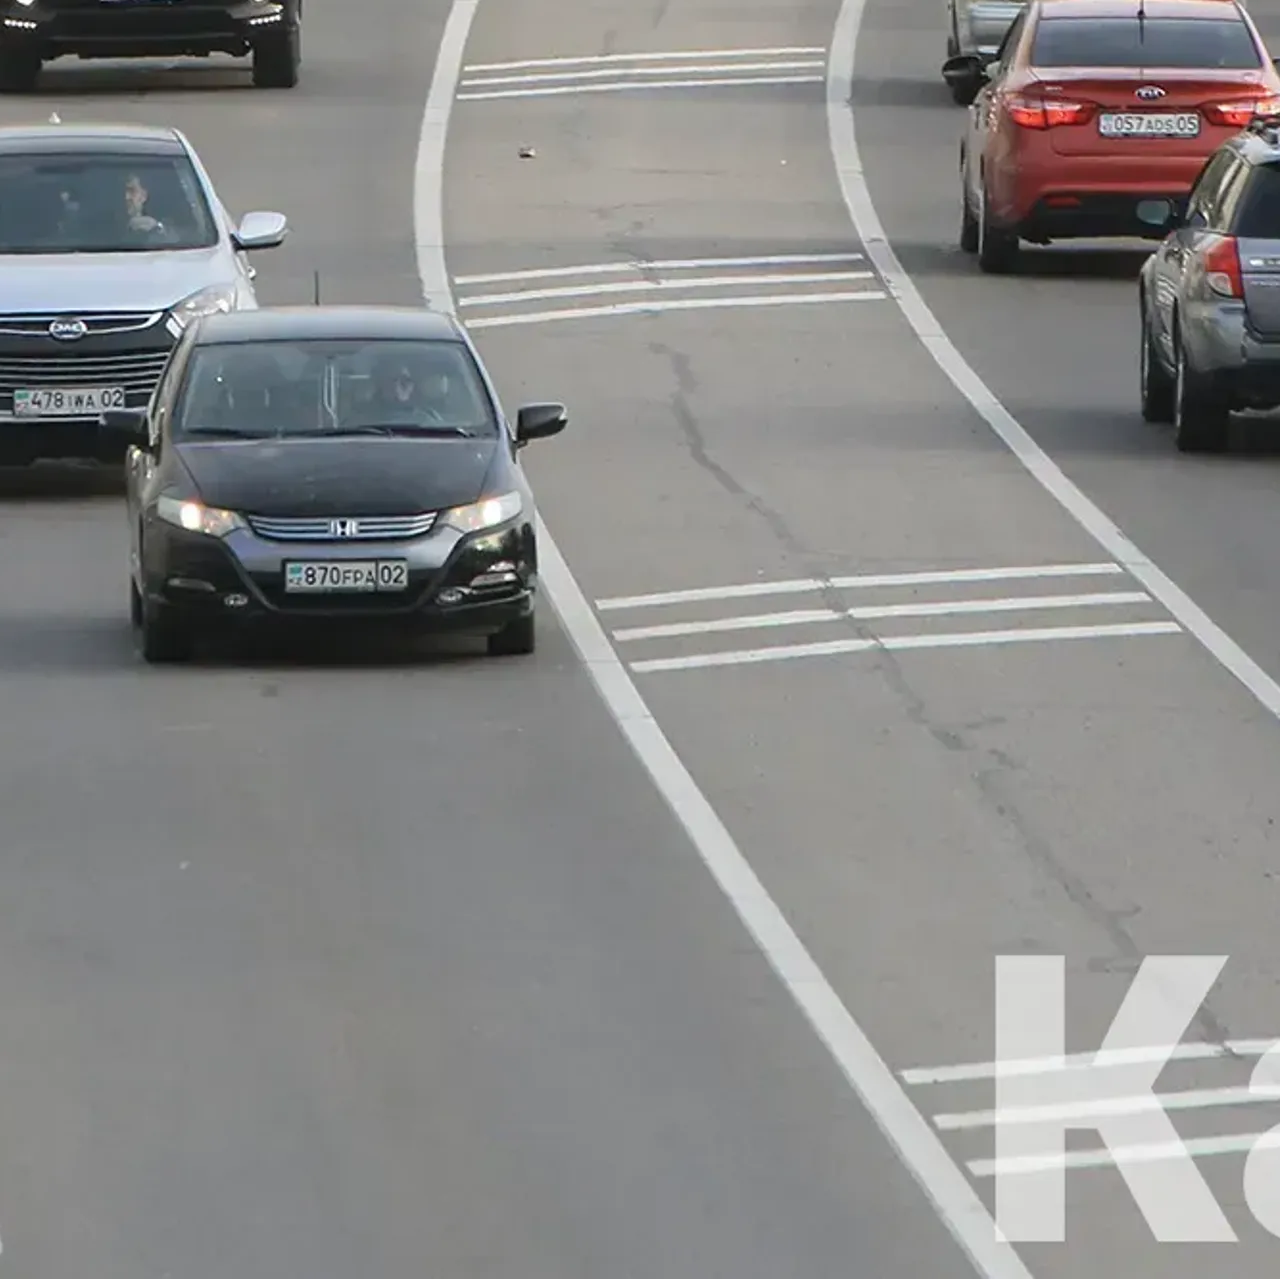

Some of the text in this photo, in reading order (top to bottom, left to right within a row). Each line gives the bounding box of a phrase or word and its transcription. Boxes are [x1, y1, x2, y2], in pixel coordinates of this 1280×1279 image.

[1177, 115, 1197, 130] 05
[100, 390, 123, 407] 02
[380, 565, 405, 585] 02
